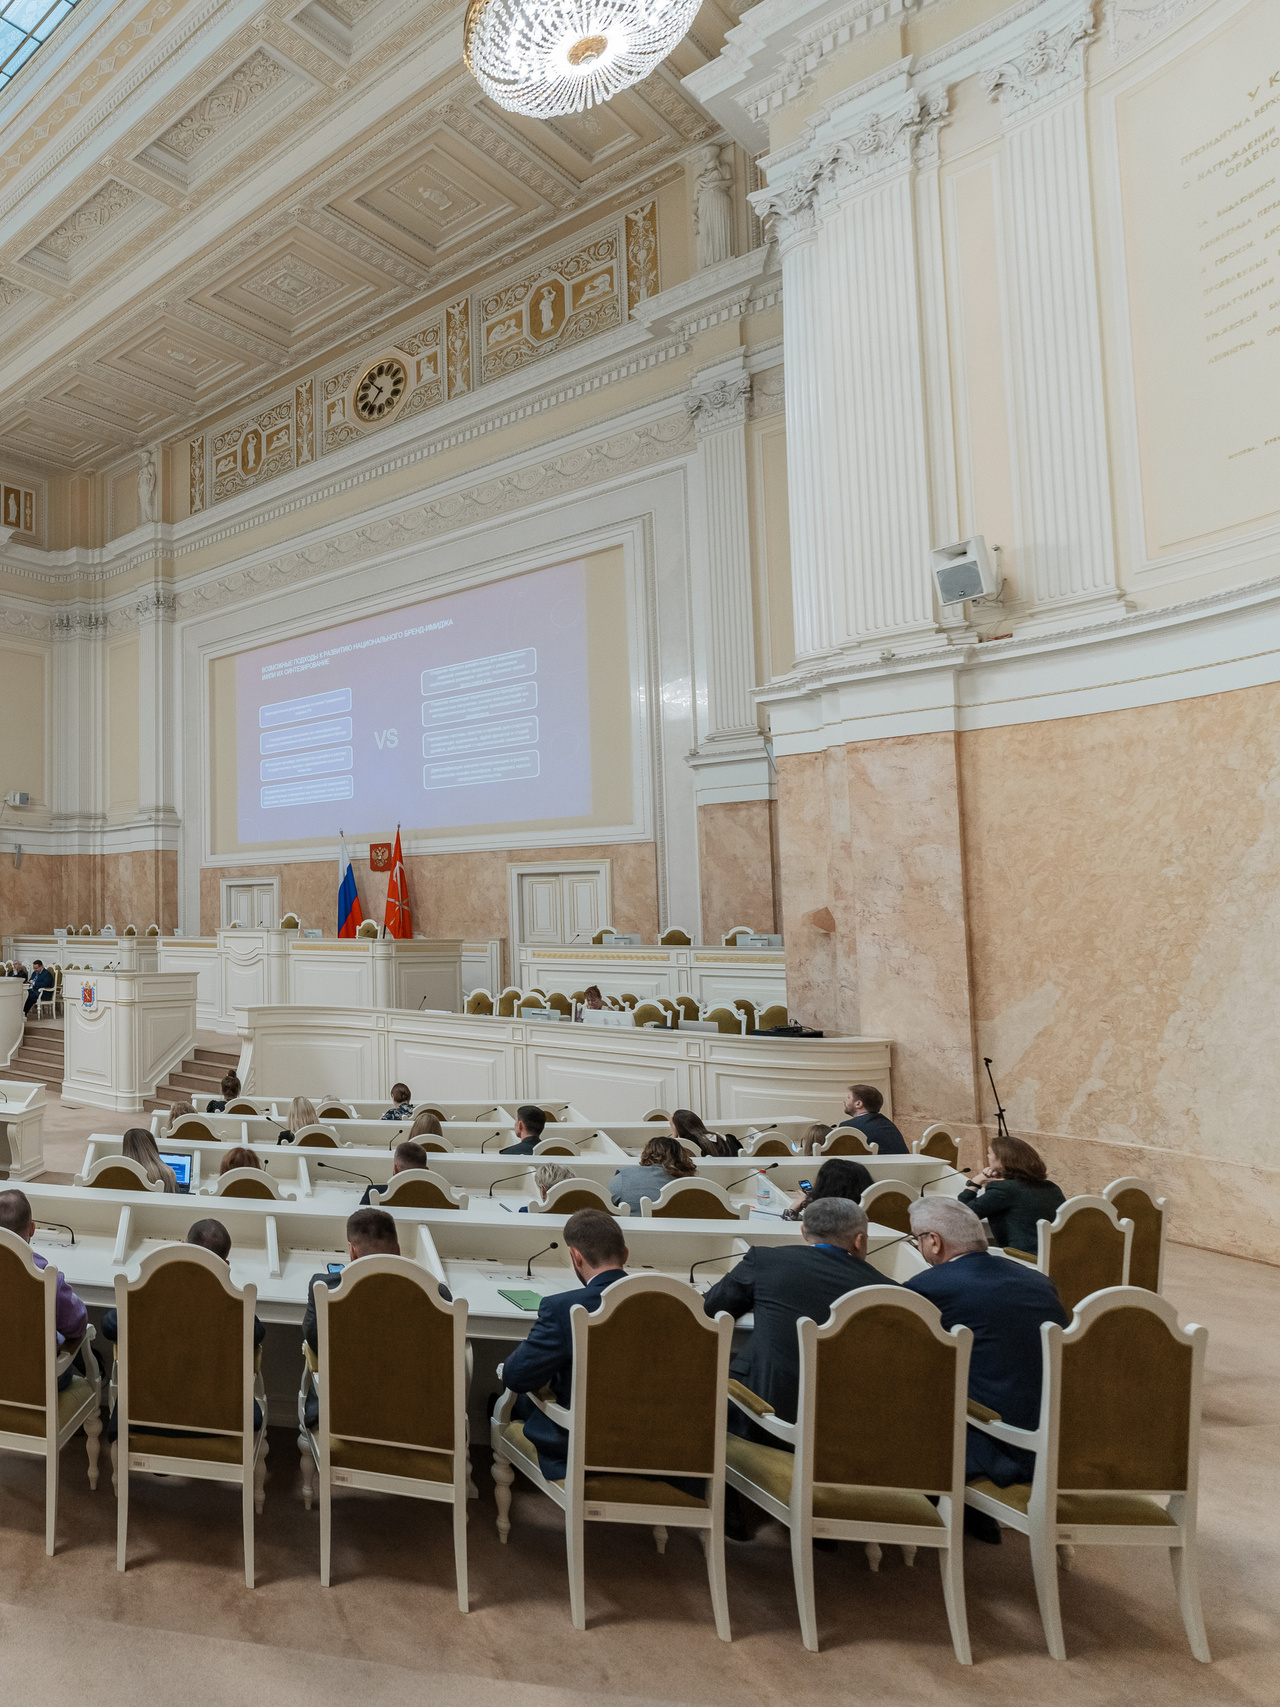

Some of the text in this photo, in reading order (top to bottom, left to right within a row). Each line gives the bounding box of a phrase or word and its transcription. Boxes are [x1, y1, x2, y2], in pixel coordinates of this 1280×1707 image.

[1180, 117, 1250, 165] ПРЕЗИДИУМА
[1197, 126, 1275, 181] НАГРАЖДЕНИИ
[261, 659, 293, 673] ВОЗМОЖНЫЕ
[293, 653, 319, 665] ПОДХОДЫ
[324, 645, 353, 657] РАЗВИТИЮ
[353, 632, 403, 650] НАЦИОНАЛЬНОГО
[404, 618, 454, 637] БРЕНД-ИМИДЖА
[284, 658, 330, 675] СИНТЕЗИРОВАНИЕ
[374, 728, 399, 750] VS
